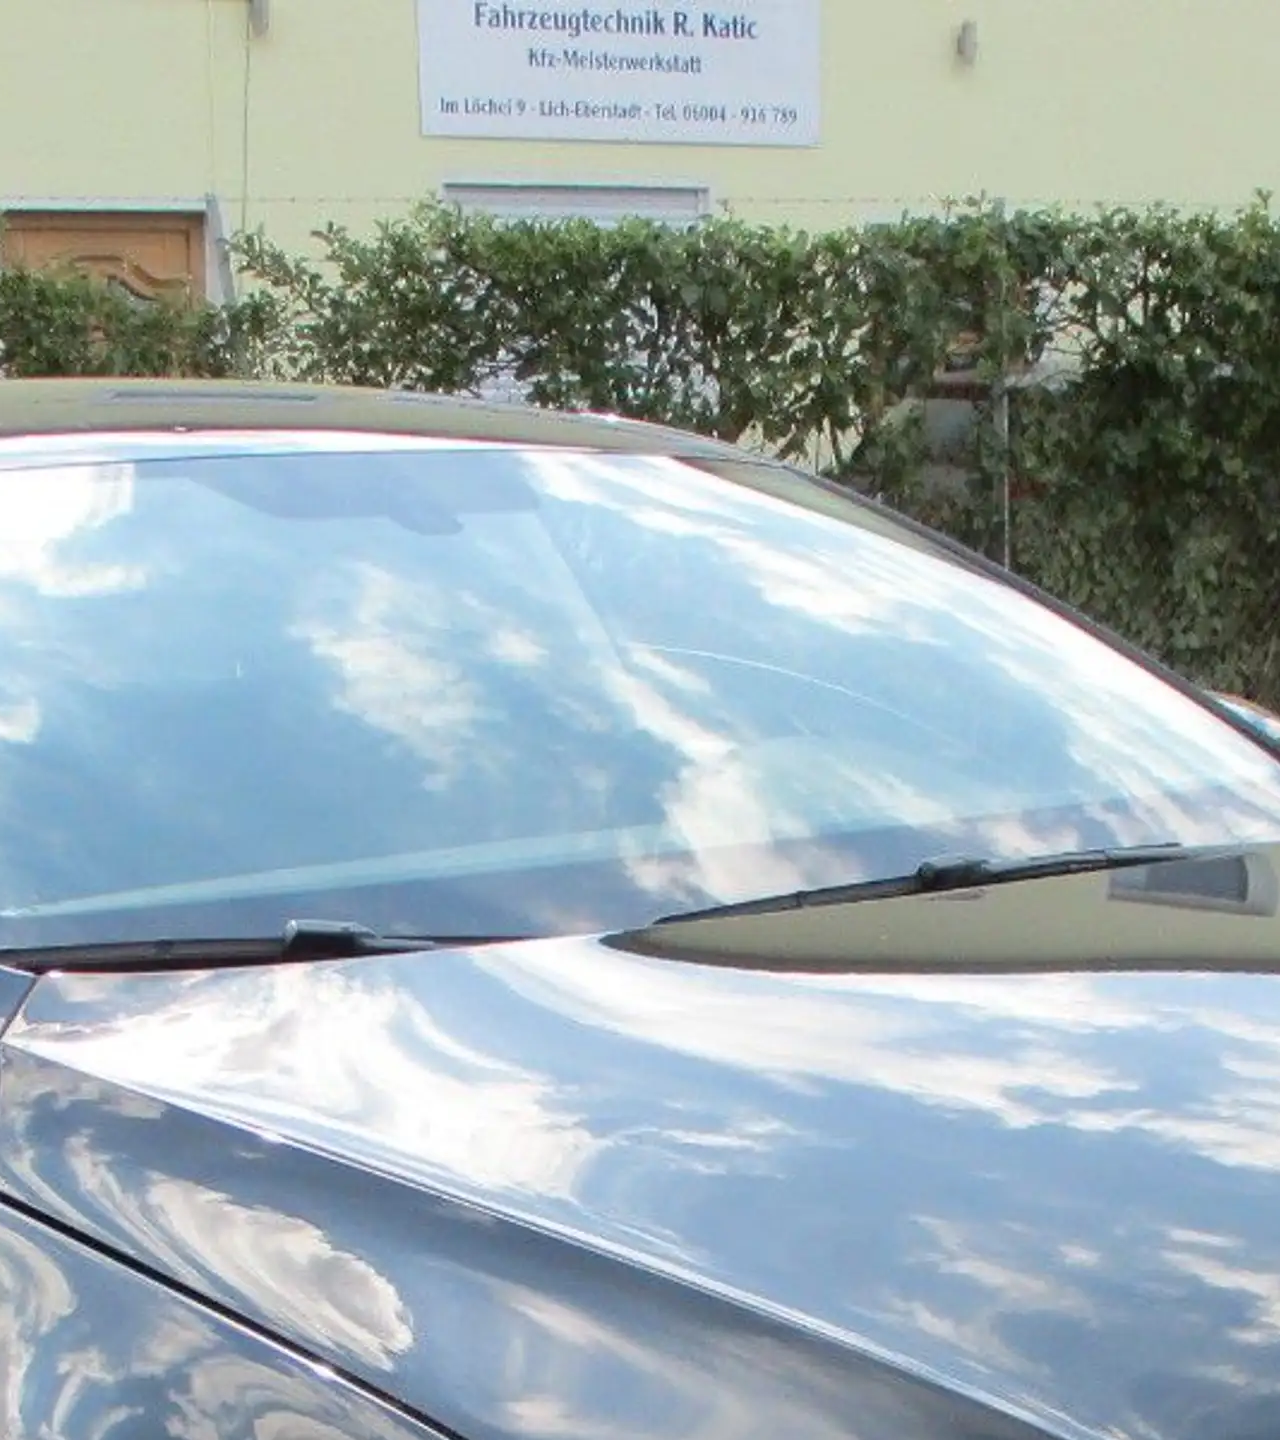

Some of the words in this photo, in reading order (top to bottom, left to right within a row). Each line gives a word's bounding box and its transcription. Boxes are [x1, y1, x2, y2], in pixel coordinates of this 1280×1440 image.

[474, 2, 666, 38] Fahrzeugtechnik
[673, 11, 694, 37] R.
[702, 12, 759, 39] Katic
[528, 48, 702, 74] Kfz-Meisterwerkstatt
[440, 97, 459, 114] Im
